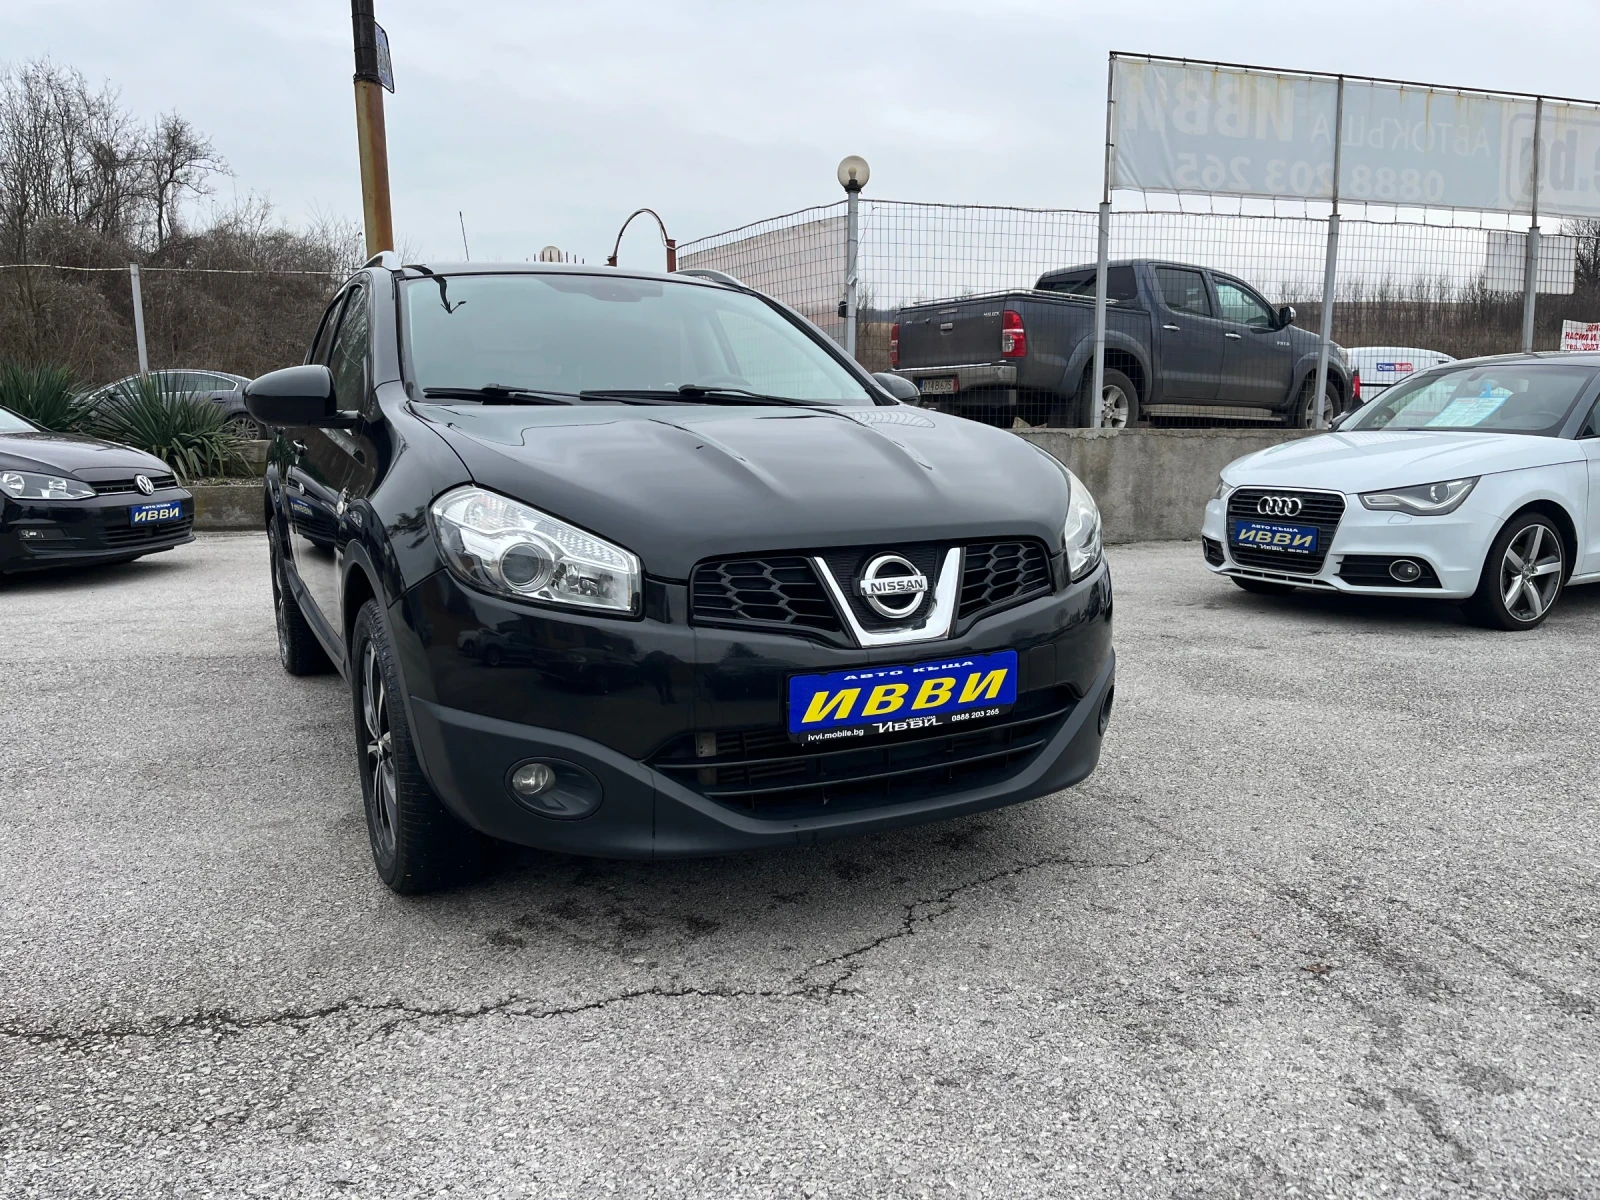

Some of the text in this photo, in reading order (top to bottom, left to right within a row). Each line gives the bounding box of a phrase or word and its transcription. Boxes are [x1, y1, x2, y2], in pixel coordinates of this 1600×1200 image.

[134, 507, 179, 522] ИВВИ
[1238, 528, 1313, 547] ИВВИ
[870, 579, 924, 593] NISSAN
[843, 660, 974, 681] АВТО КЪЩА
[801, 668, 1009, 723] ИВВИ
[971, 711, 985, 720] 203
